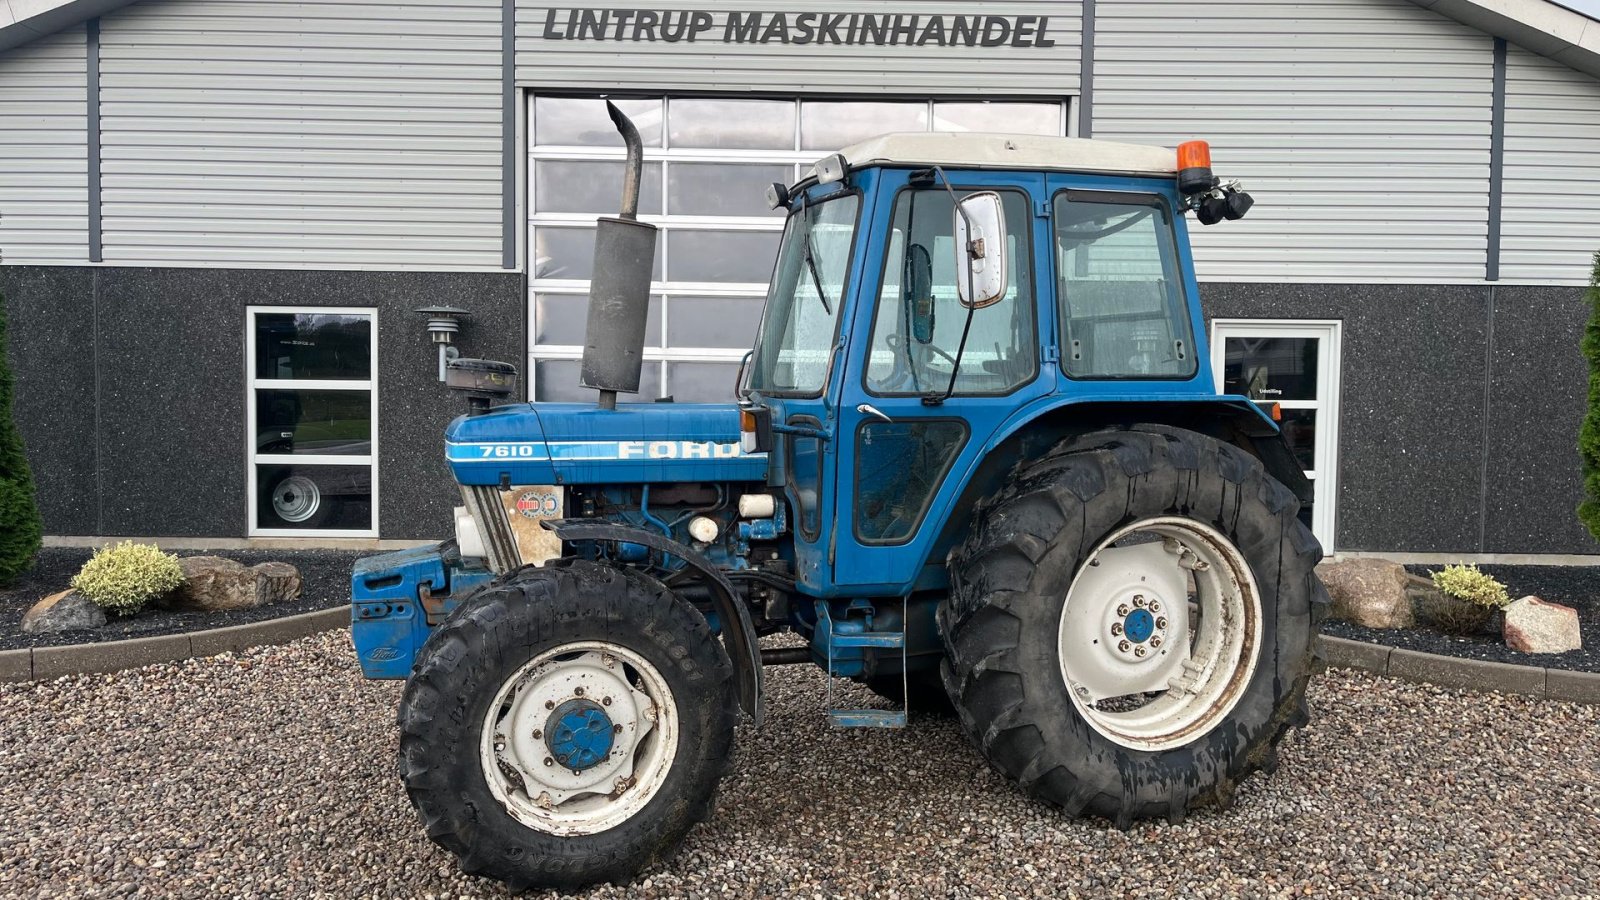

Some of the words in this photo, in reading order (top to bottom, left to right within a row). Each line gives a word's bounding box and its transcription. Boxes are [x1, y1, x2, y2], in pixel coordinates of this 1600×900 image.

[543, 9, 713, 43] LINTRUP
[722, 12, 1056, 47] MASKINHANDEL
[479, 445, 533, 457] 7610
[618, 441, 741, 459] FORD
